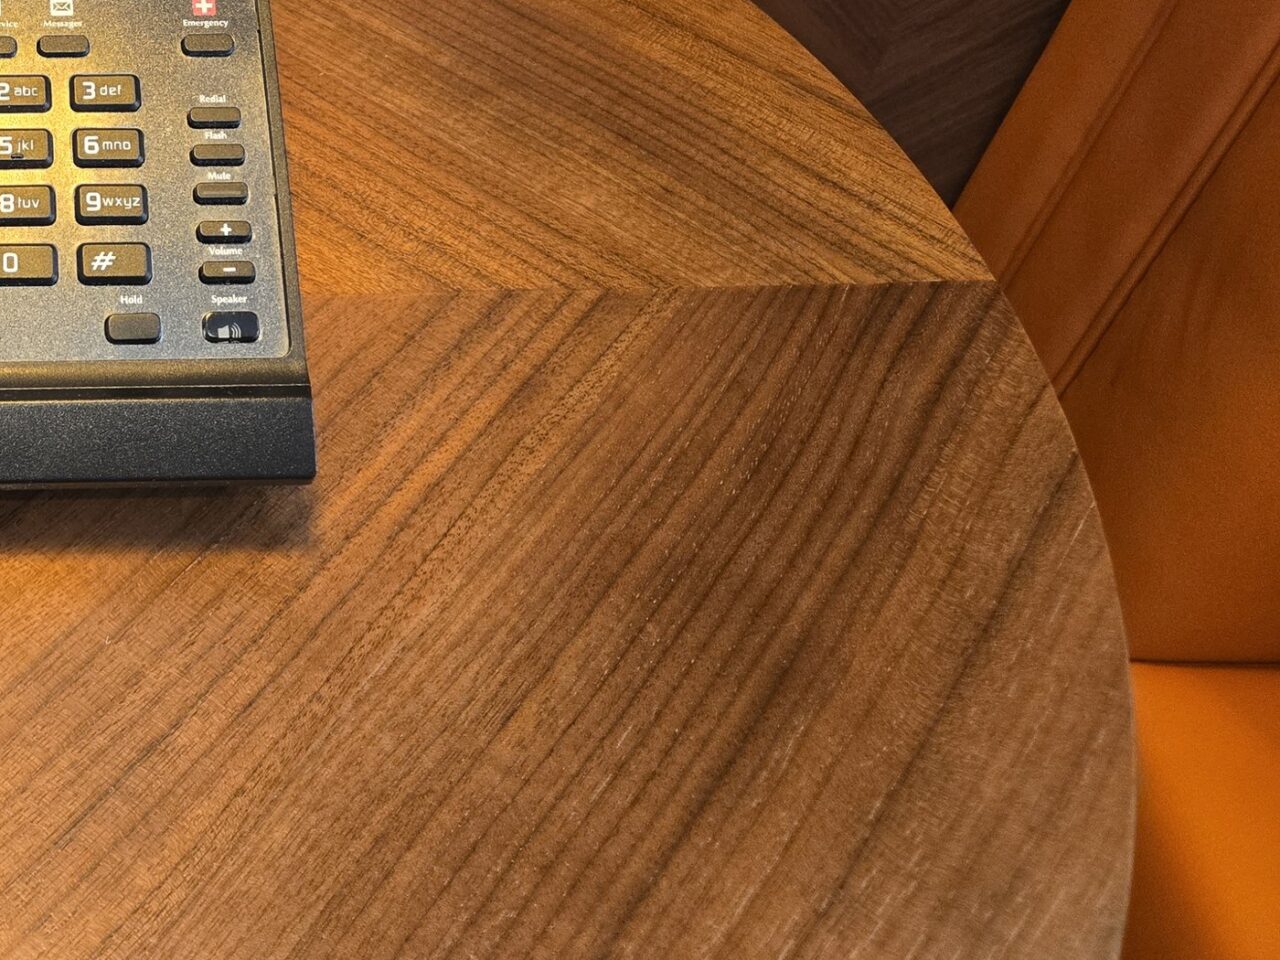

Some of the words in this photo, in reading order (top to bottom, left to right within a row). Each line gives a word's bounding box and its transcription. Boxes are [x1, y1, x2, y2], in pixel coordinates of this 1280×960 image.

[42, 20, 83, 30] Messages
[182, 19, 229, 28] Emergency
[82, 81, 96, 100] 3
[199, 95, 226, 103] Redial
[205, 131, 227, 140] Flash
[83, 136, 100, 155] 6
[207, 172, 231, 180] Mute
[209, 247, 243, 255] Volume
[3, 253, 18, 273] 0
[91, 251, 116, 271] #
[120, 295, 143, 305] Hold
[211, 295, 247, 305] Speaker
